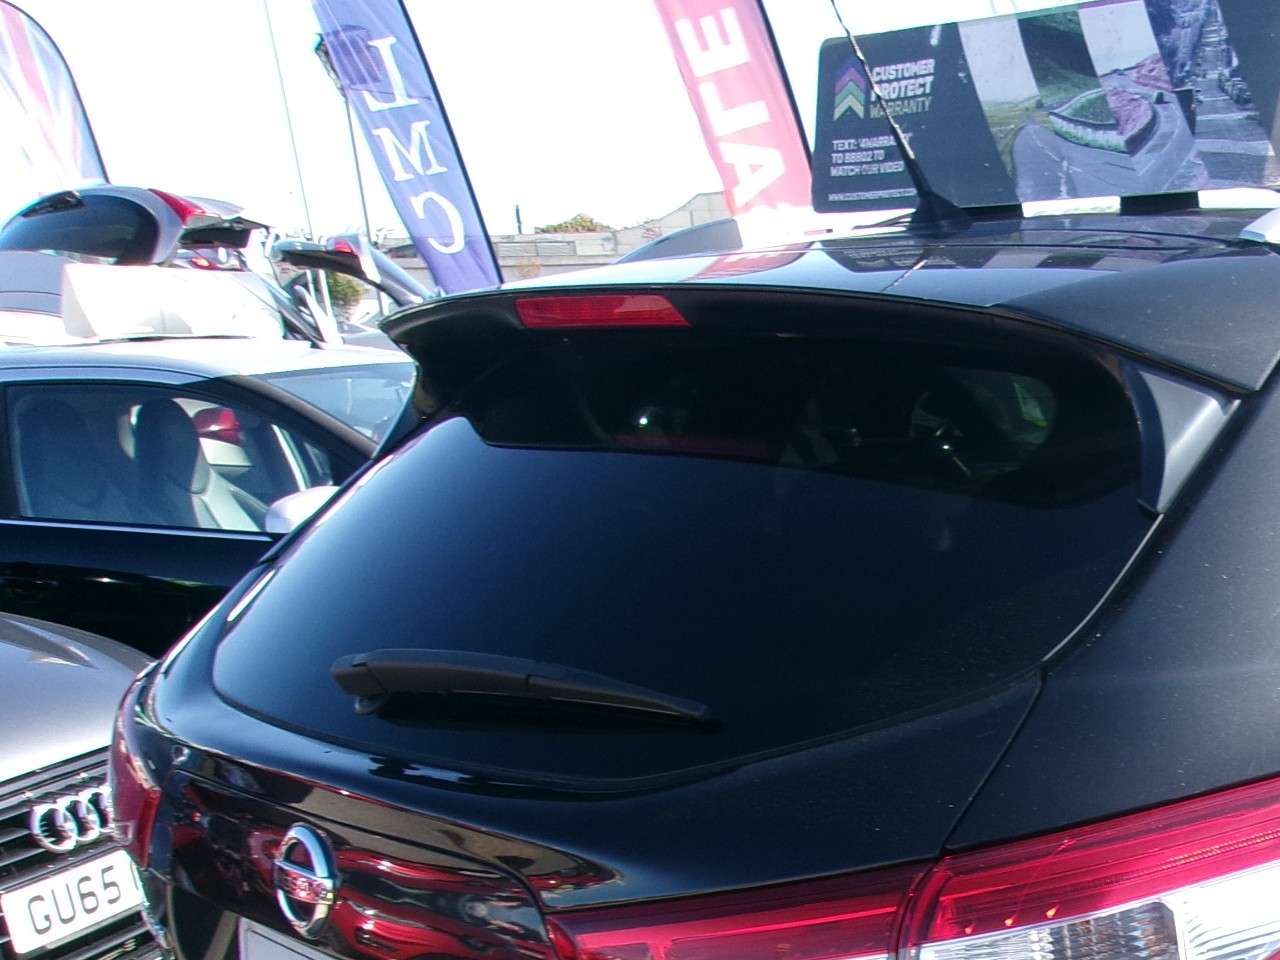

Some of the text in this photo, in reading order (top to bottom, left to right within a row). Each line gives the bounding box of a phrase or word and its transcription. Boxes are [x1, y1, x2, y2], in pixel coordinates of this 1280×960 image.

[872, 59, 936, 82] CUSTOMER
[870, 76, 934, 102] PROTECT
[869, 96, 933, 119] WARRANTY
[27, 864, 122, 935] GU65
